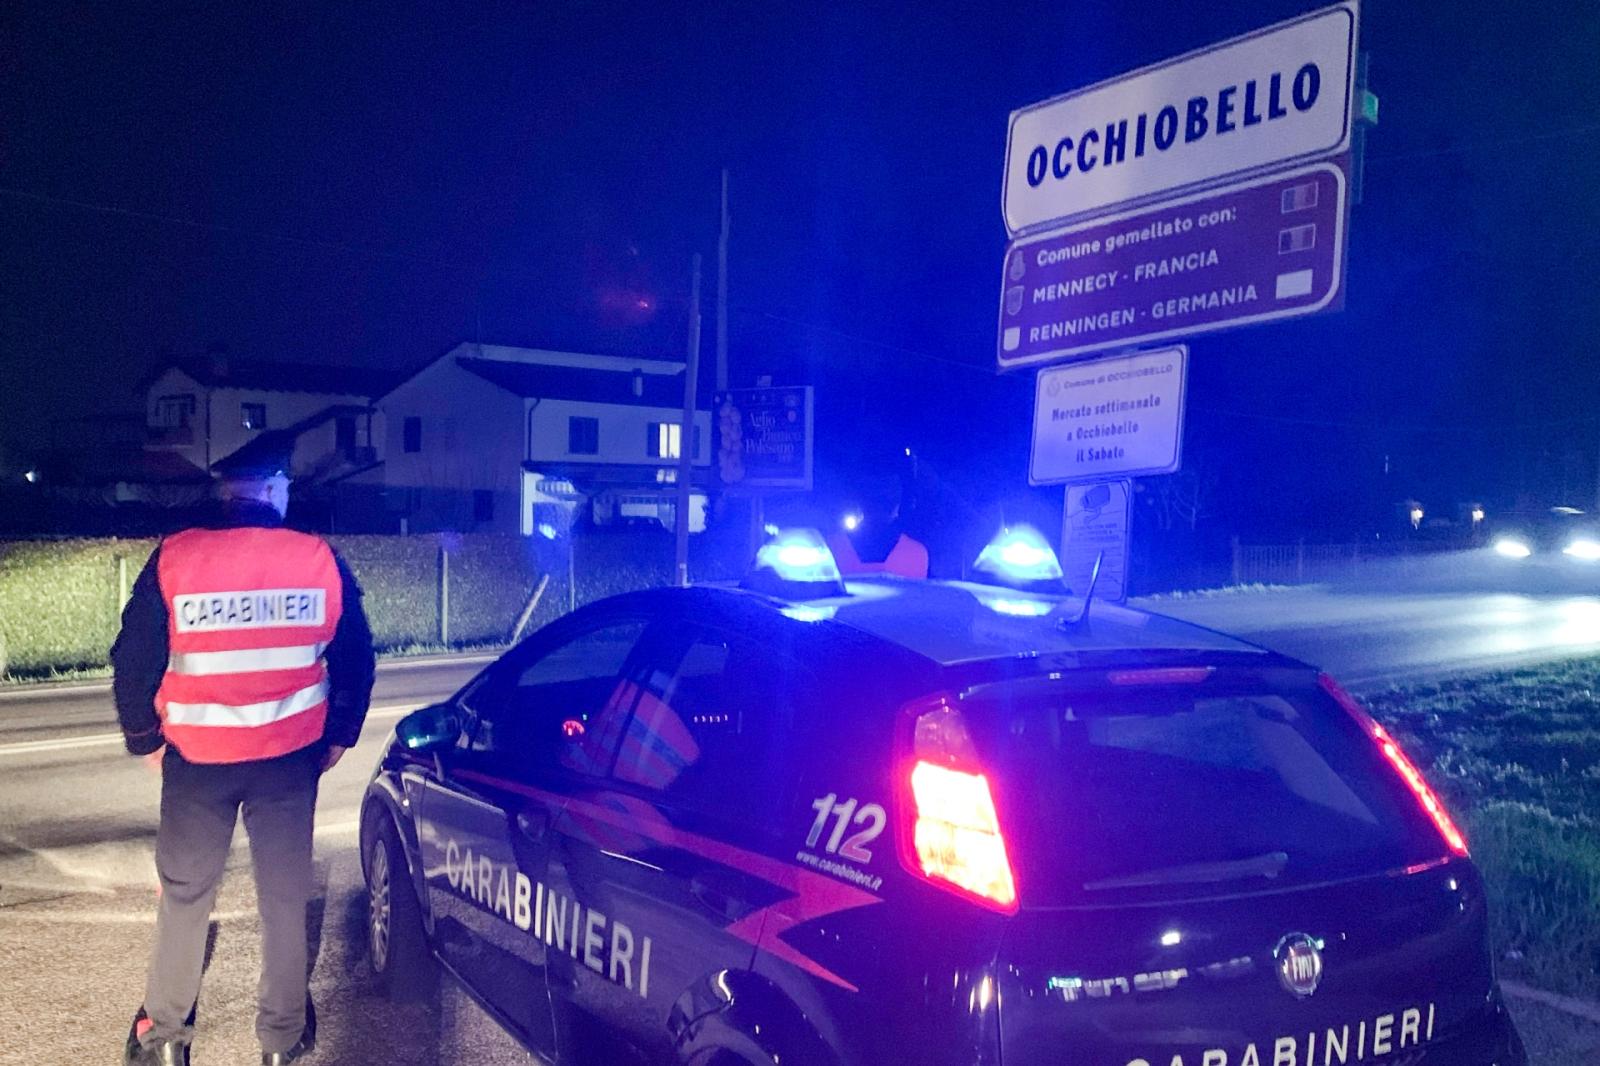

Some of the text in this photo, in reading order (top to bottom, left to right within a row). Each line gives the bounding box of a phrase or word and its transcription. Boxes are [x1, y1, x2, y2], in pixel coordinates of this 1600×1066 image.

[1027, 62, 1321, 188] OCCHIOBELLO
[1037, 207, 1237, 267] Comune gemellato con:
[1033, 271, 1118, 303] MENNECY
[1134, 248, 1219, 281] FRANCIA
[1029, 308, 1135, 342] RENNINGEN
[1152, 284, 1258, 318] GERMANIA
[1107, 364, 1173, 383] OCCHIOBELLO
[1052, 404, 1091, 420] Mercato
[1077, 421, 1139, 440] Occhiobello
[1088, 446, 1124, 461] Sabato
[182, 594, 318, 626] CARABINIERI
[806, 793, 886, 864] 112
[796, 851, 882, 891] www.carabinieri.it
[445, 839, 652, 999] CARABINIERI
[1126, 1003, 1435, 1066] ABINIERI
